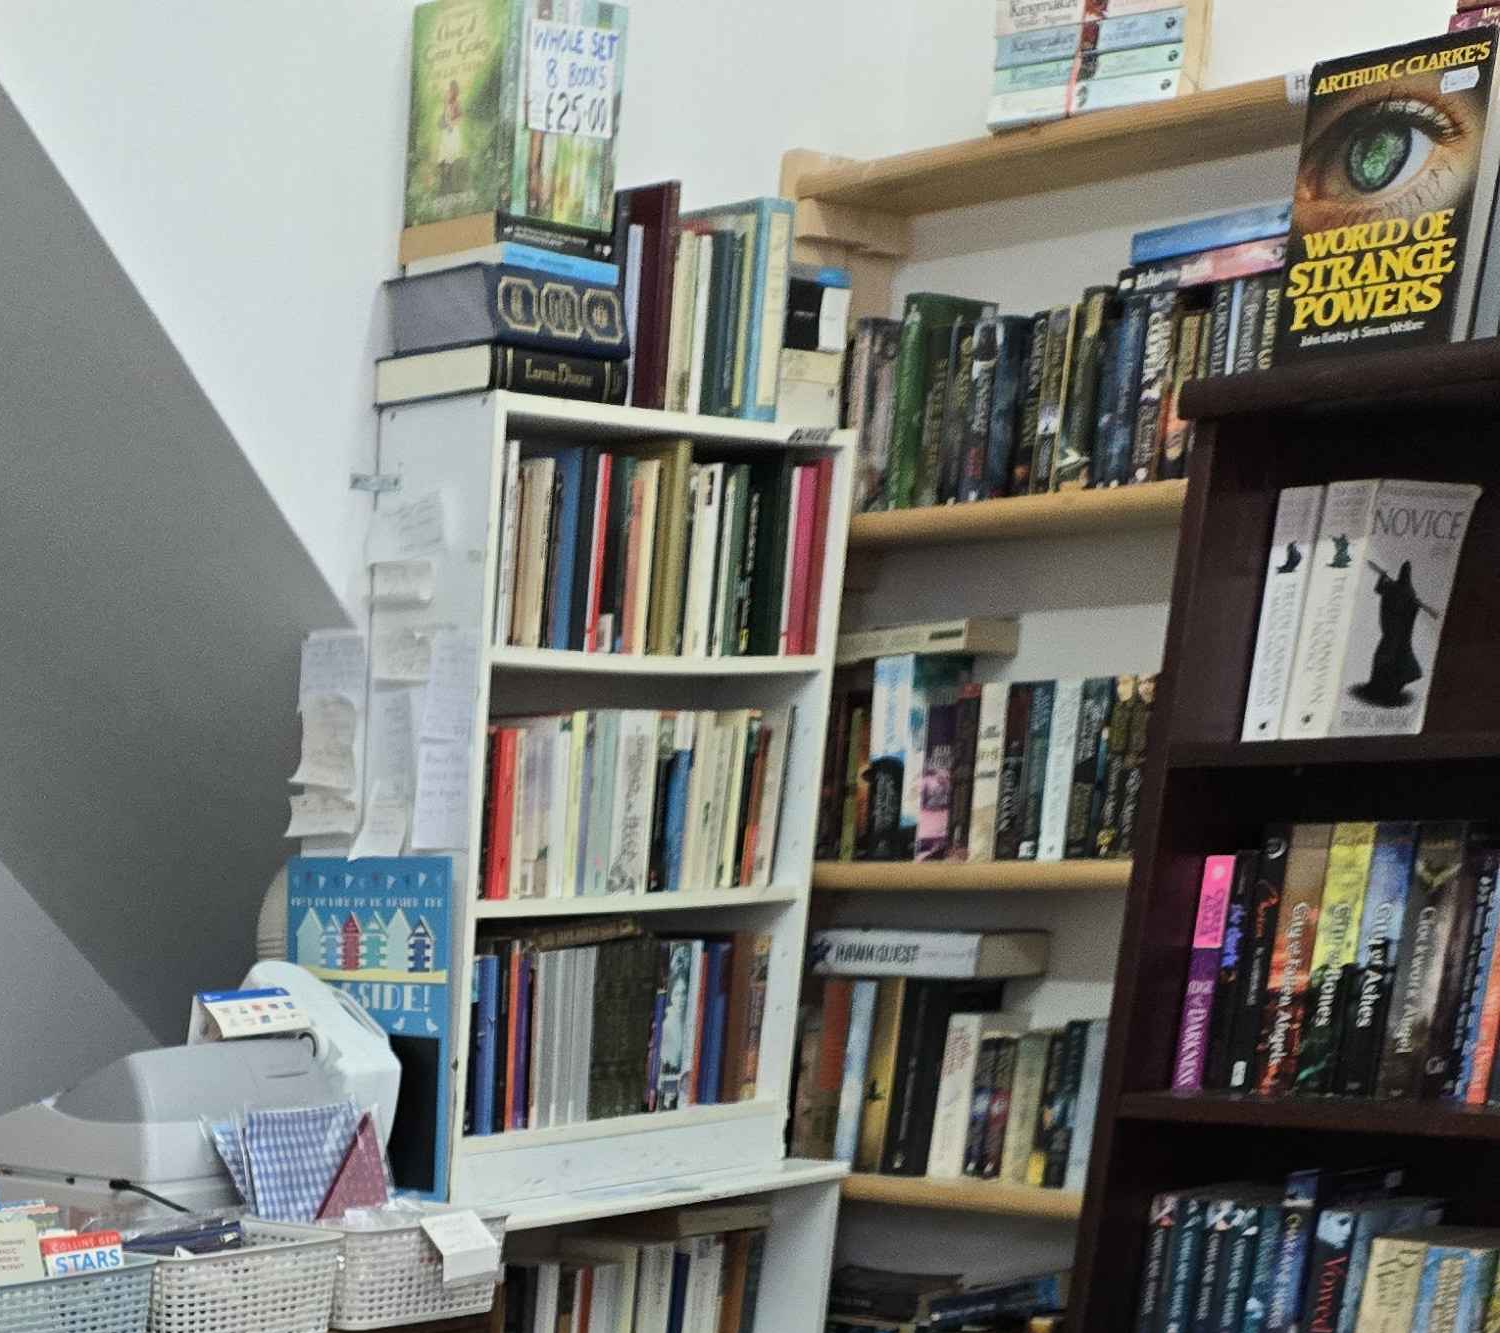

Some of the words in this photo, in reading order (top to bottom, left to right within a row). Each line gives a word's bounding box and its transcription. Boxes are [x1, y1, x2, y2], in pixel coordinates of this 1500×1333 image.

[1314, 66, 1392, 97] ARTHUR
[1302, 216, 1409, 258] WORLD
[1412, 207, 1455, 241] OF
[1286, 238, 1456, 298] STRANGE
[1288, 276, 1443, 333] POWERS
[1370, 507, 1464, 542] NOVICE
[54, 1248, 121, 1274] STARS
